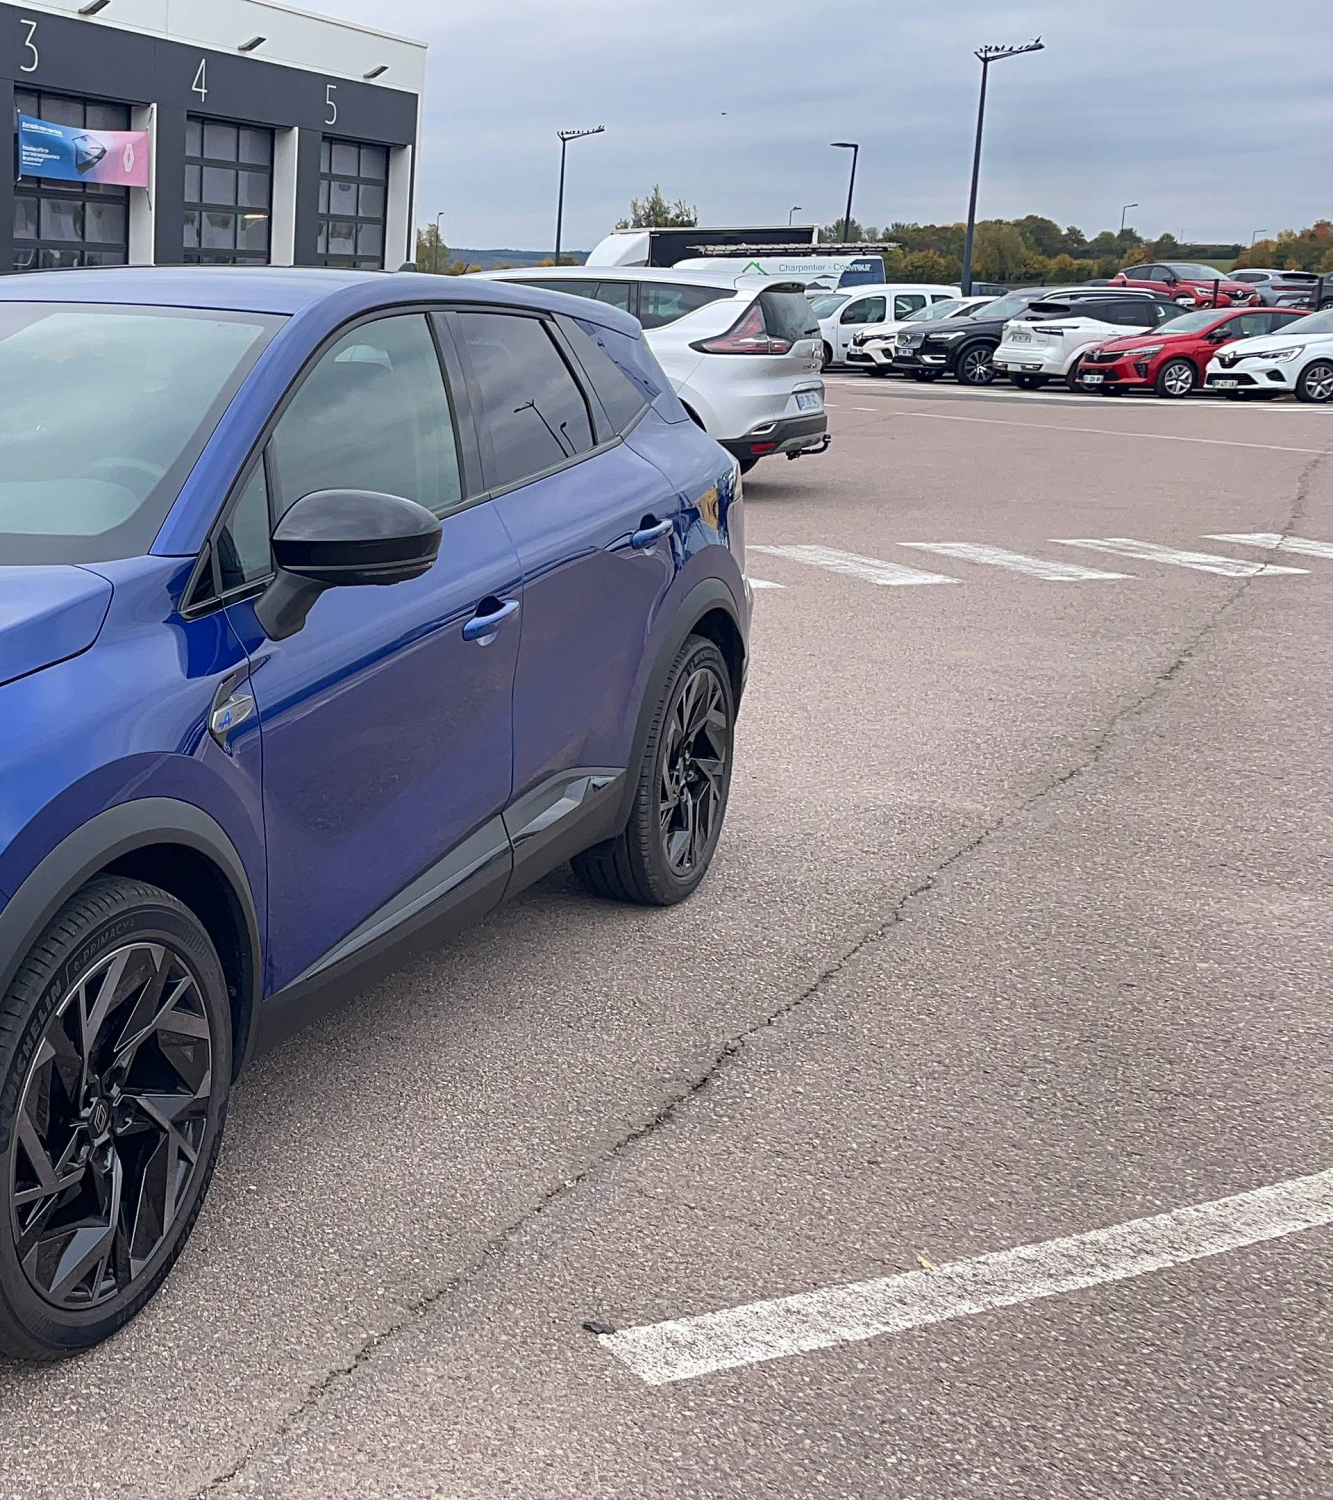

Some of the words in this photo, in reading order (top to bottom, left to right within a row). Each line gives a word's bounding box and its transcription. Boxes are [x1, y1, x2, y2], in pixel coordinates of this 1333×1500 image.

[20, 19, 39, 72] 3
[191, 58, 208, 103] 4
[325, 84, 337, 125] 5
[779, 263, 825, 273] Charpentier
